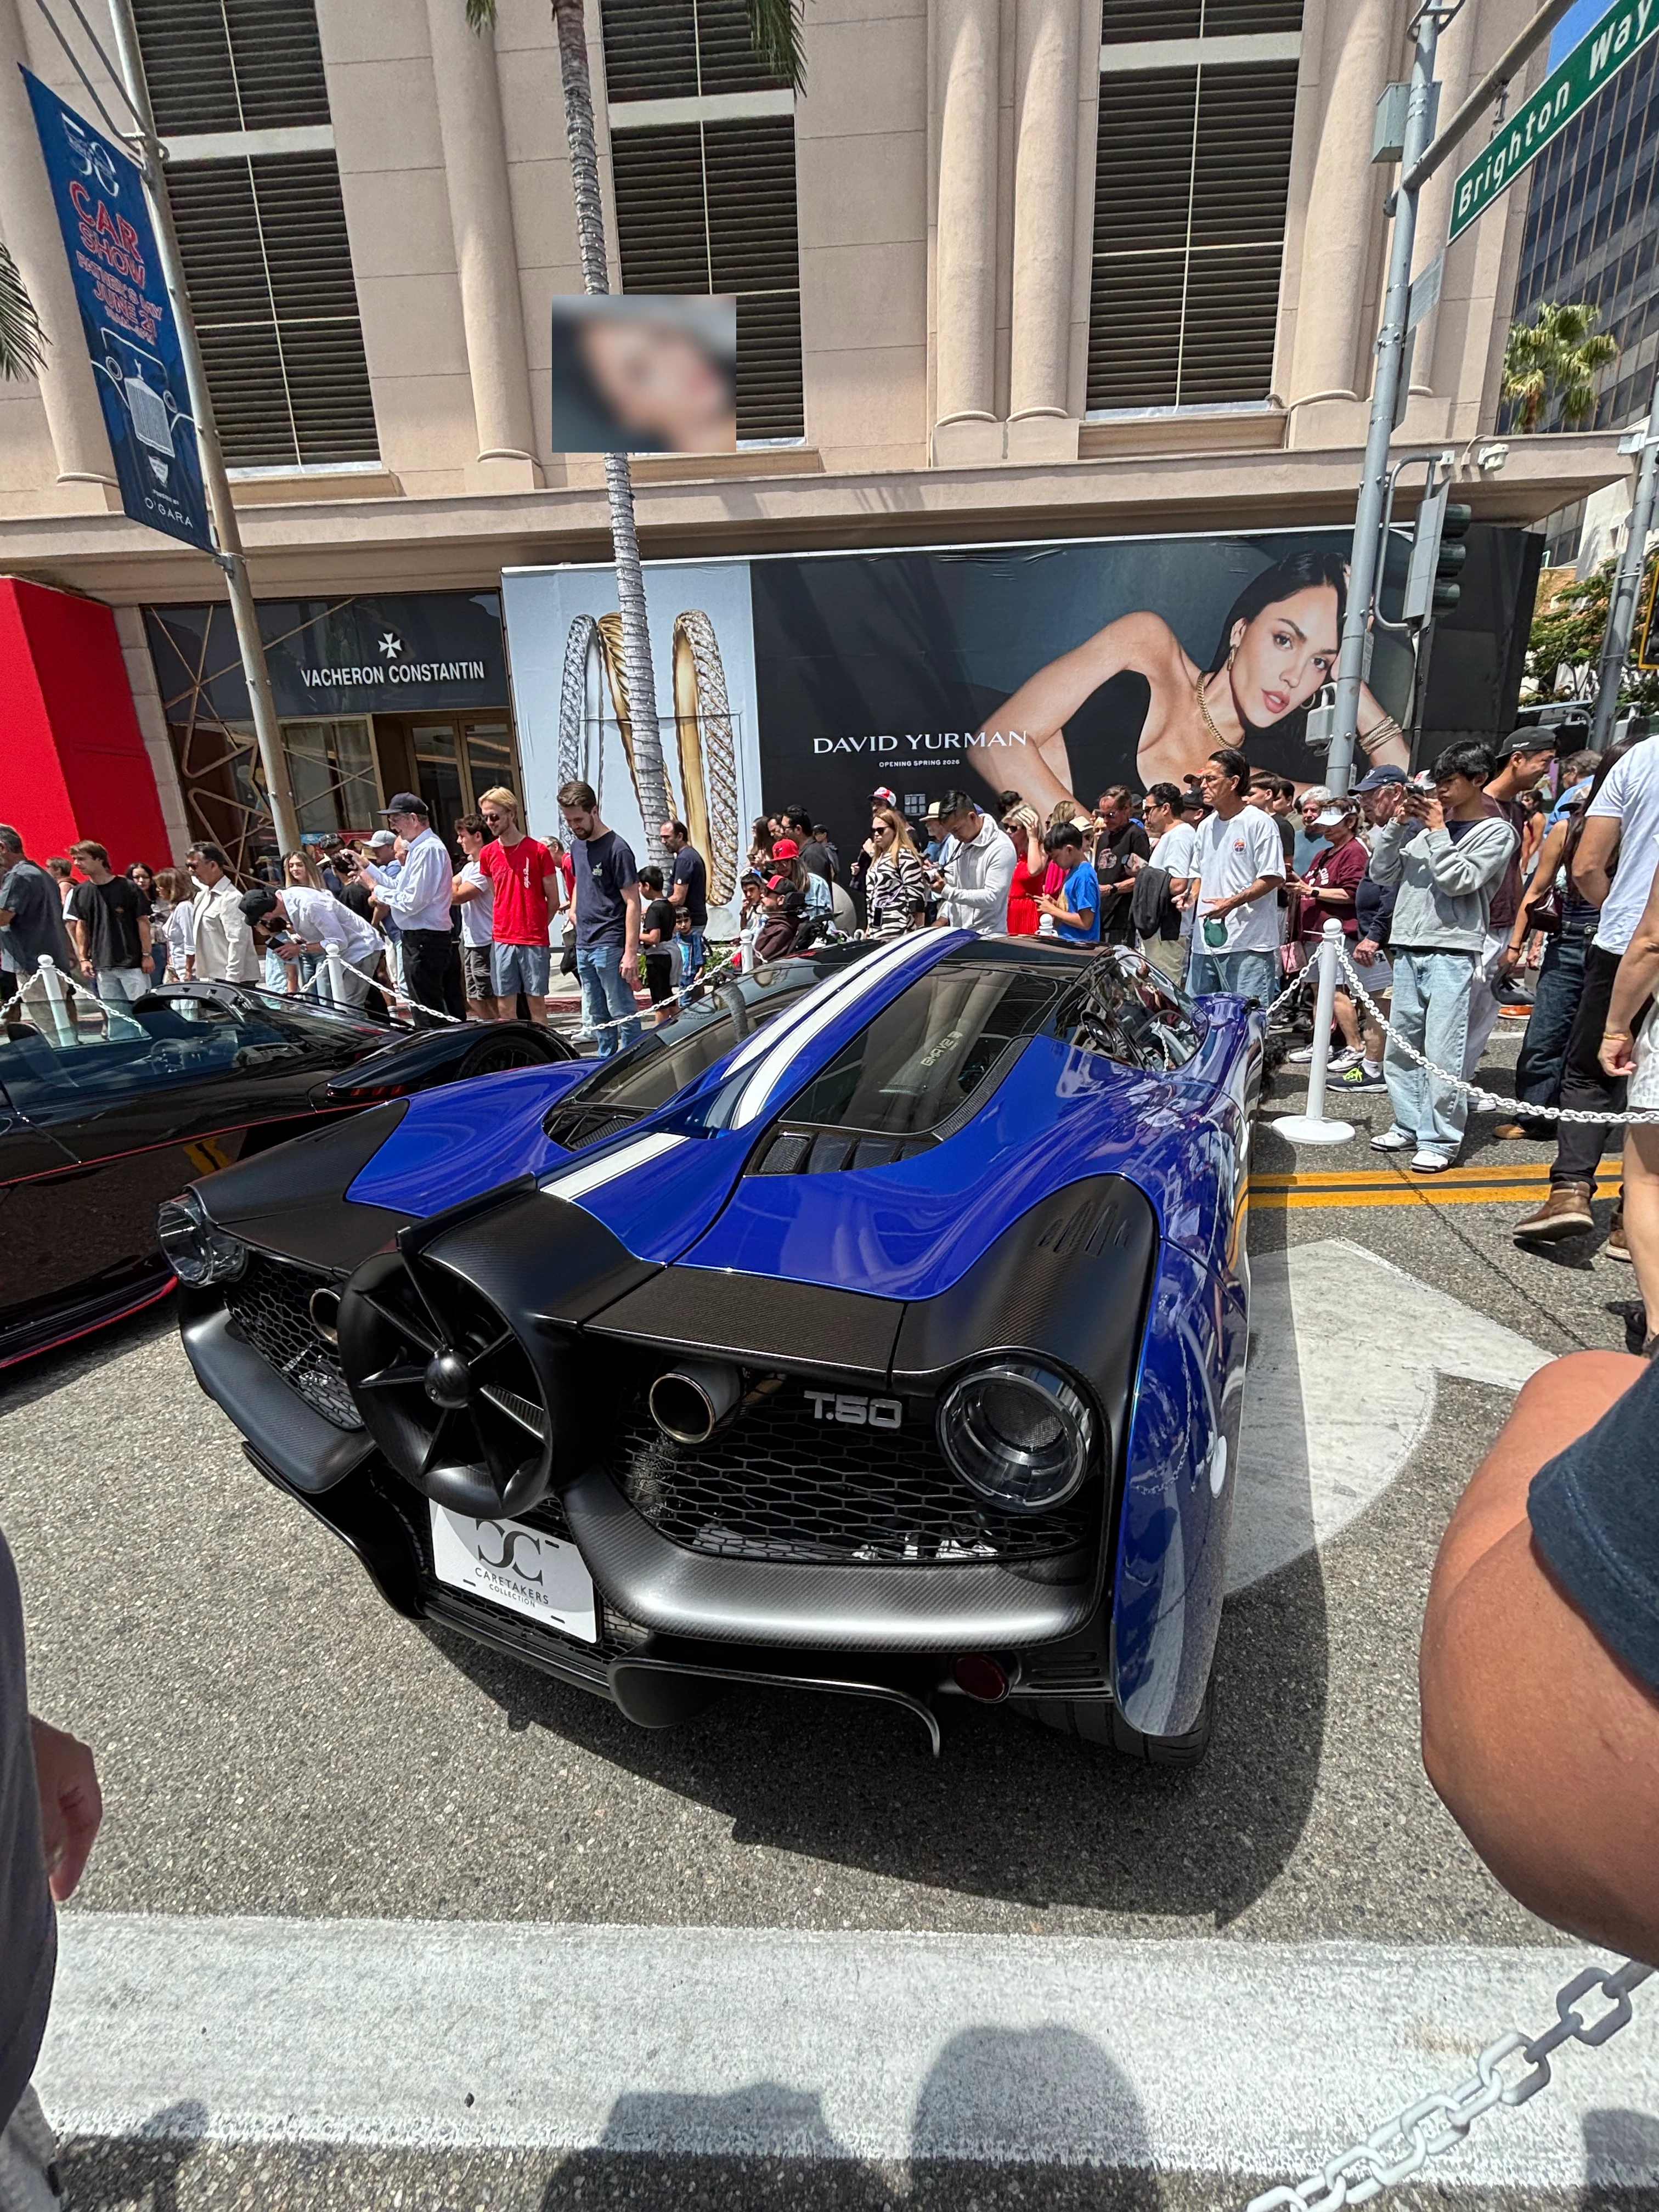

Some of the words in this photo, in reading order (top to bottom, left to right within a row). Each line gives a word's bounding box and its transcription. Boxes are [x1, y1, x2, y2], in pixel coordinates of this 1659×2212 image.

[1457, 81, 1570, 219] Brighton
[1589, 0, 1652, 81] Way
[70, 180, 144, 264] CAR
[79, 222, 145, 290] SHOW
[93, 280, 138, 325] JUNE
[144, 497, 193, 528] O'GARA
[301, 665, 384, 687] VACHERON
[388, 661, 485, 684] CONSTANTIN
[813, 735, 898, 754] DAVID
[905, 730, 1027, 751] YURMAN
[920, 1048, 945, 1066] GMA
[803, 1390, 902, 1429] T.50
[475, 1567, 549, 1605] CARETAKERS
[489, 1583, 535, 1607] COLLECTION
